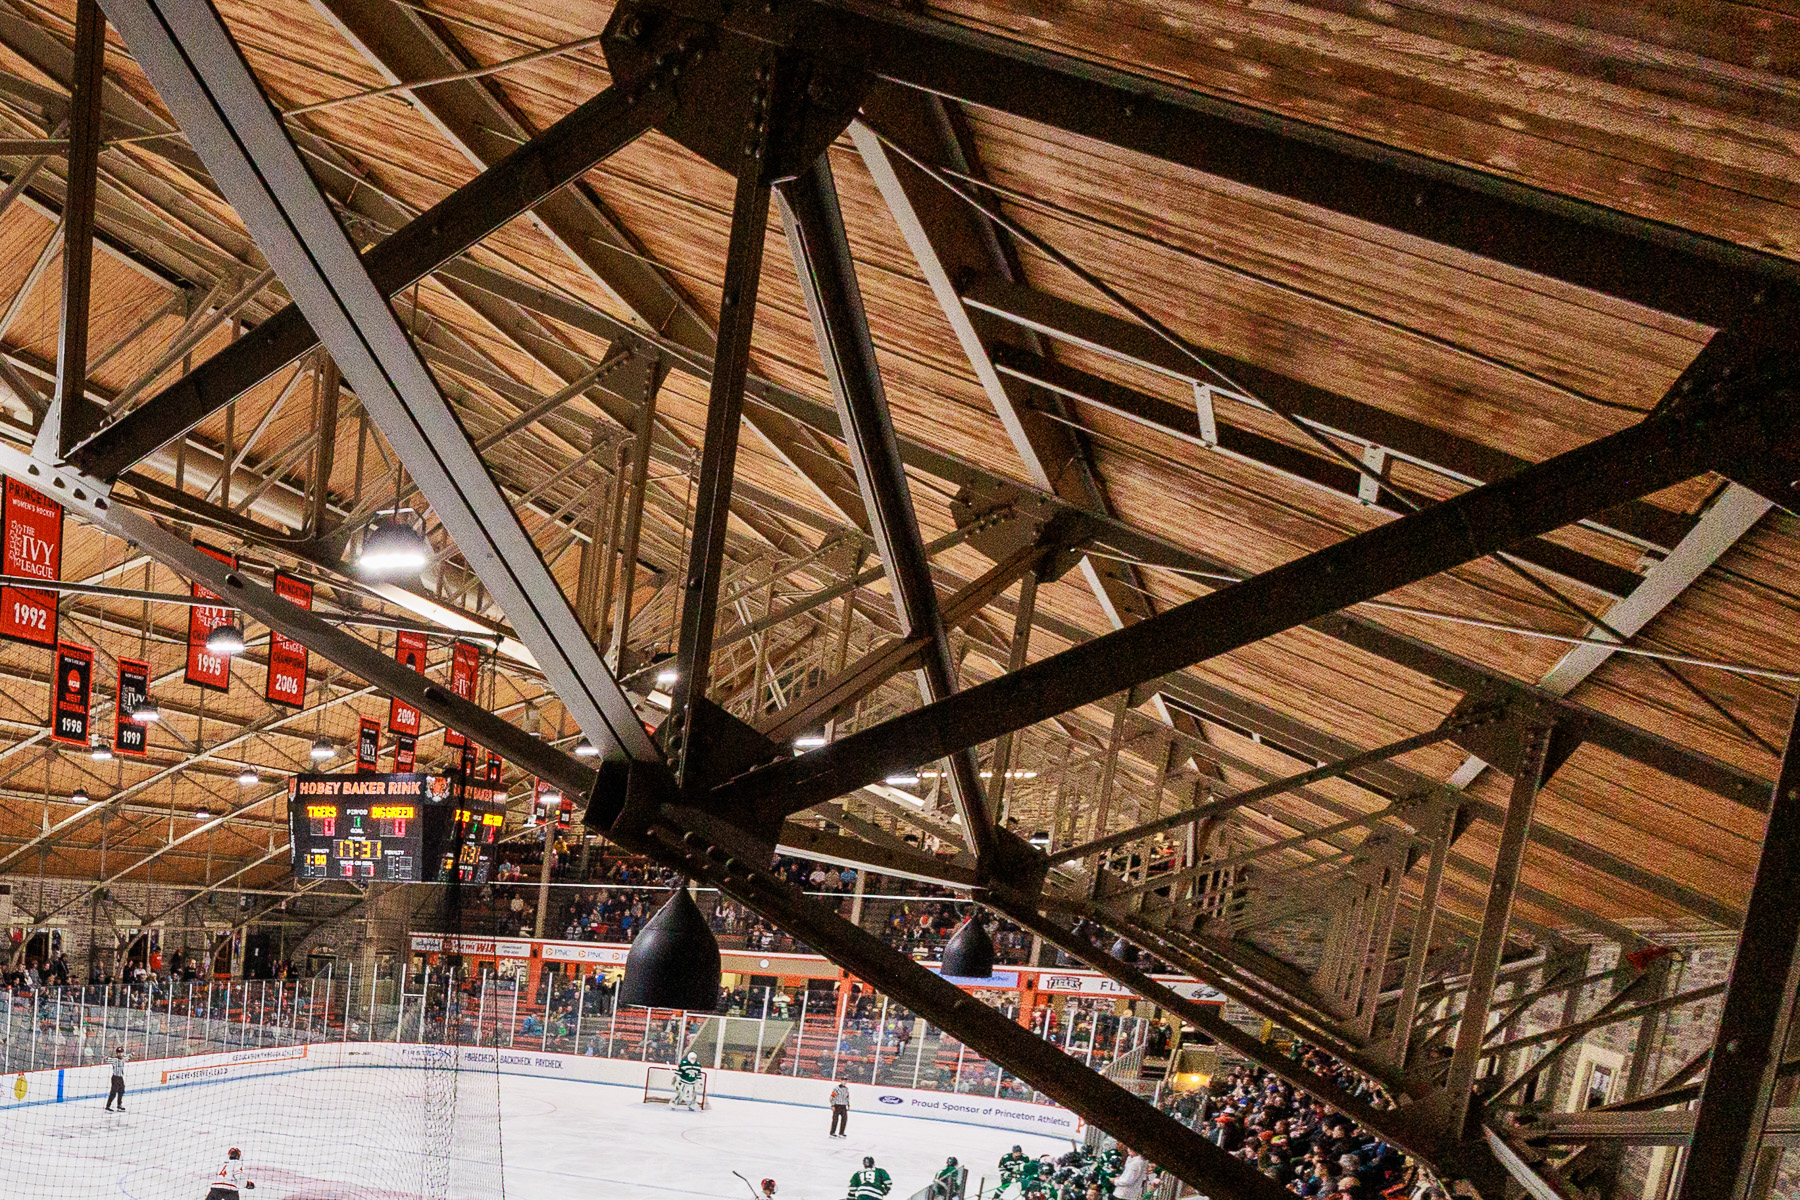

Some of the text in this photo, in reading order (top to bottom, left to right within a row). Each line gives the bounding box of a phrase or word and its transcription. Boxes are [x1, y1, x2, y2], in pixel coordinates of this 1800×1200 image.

[22, 524, 35, 536] THE
[22, 535, 54, 565] IVY
[21, 561, 54, 579] LEAGUE
[14, 602, 47, 630] 1992
[197, 653, 222, 676] 1995
[275, 673, 298, 694] 2006
[62, 717, 82, 734] 1998
[397, 708, 415, 726] 2006
[123, 730, 141, 745] 1999
[300, 781, 421, 795] HOBEY BAKER RINK
[307, 806, 337, 818] TIGERS
[324, 818, 335, 836] 0
[394, 818, 406, 837] 0
[339, 840, 381, 859] 17:31
[555, 949, 571, 957] PNC
[587, 951, 604, 959] PNC
[911, 1099, 1071, 1127] Proud Sponsor of Princeton Athletics
[859, 1171, 876, 1184] 19
